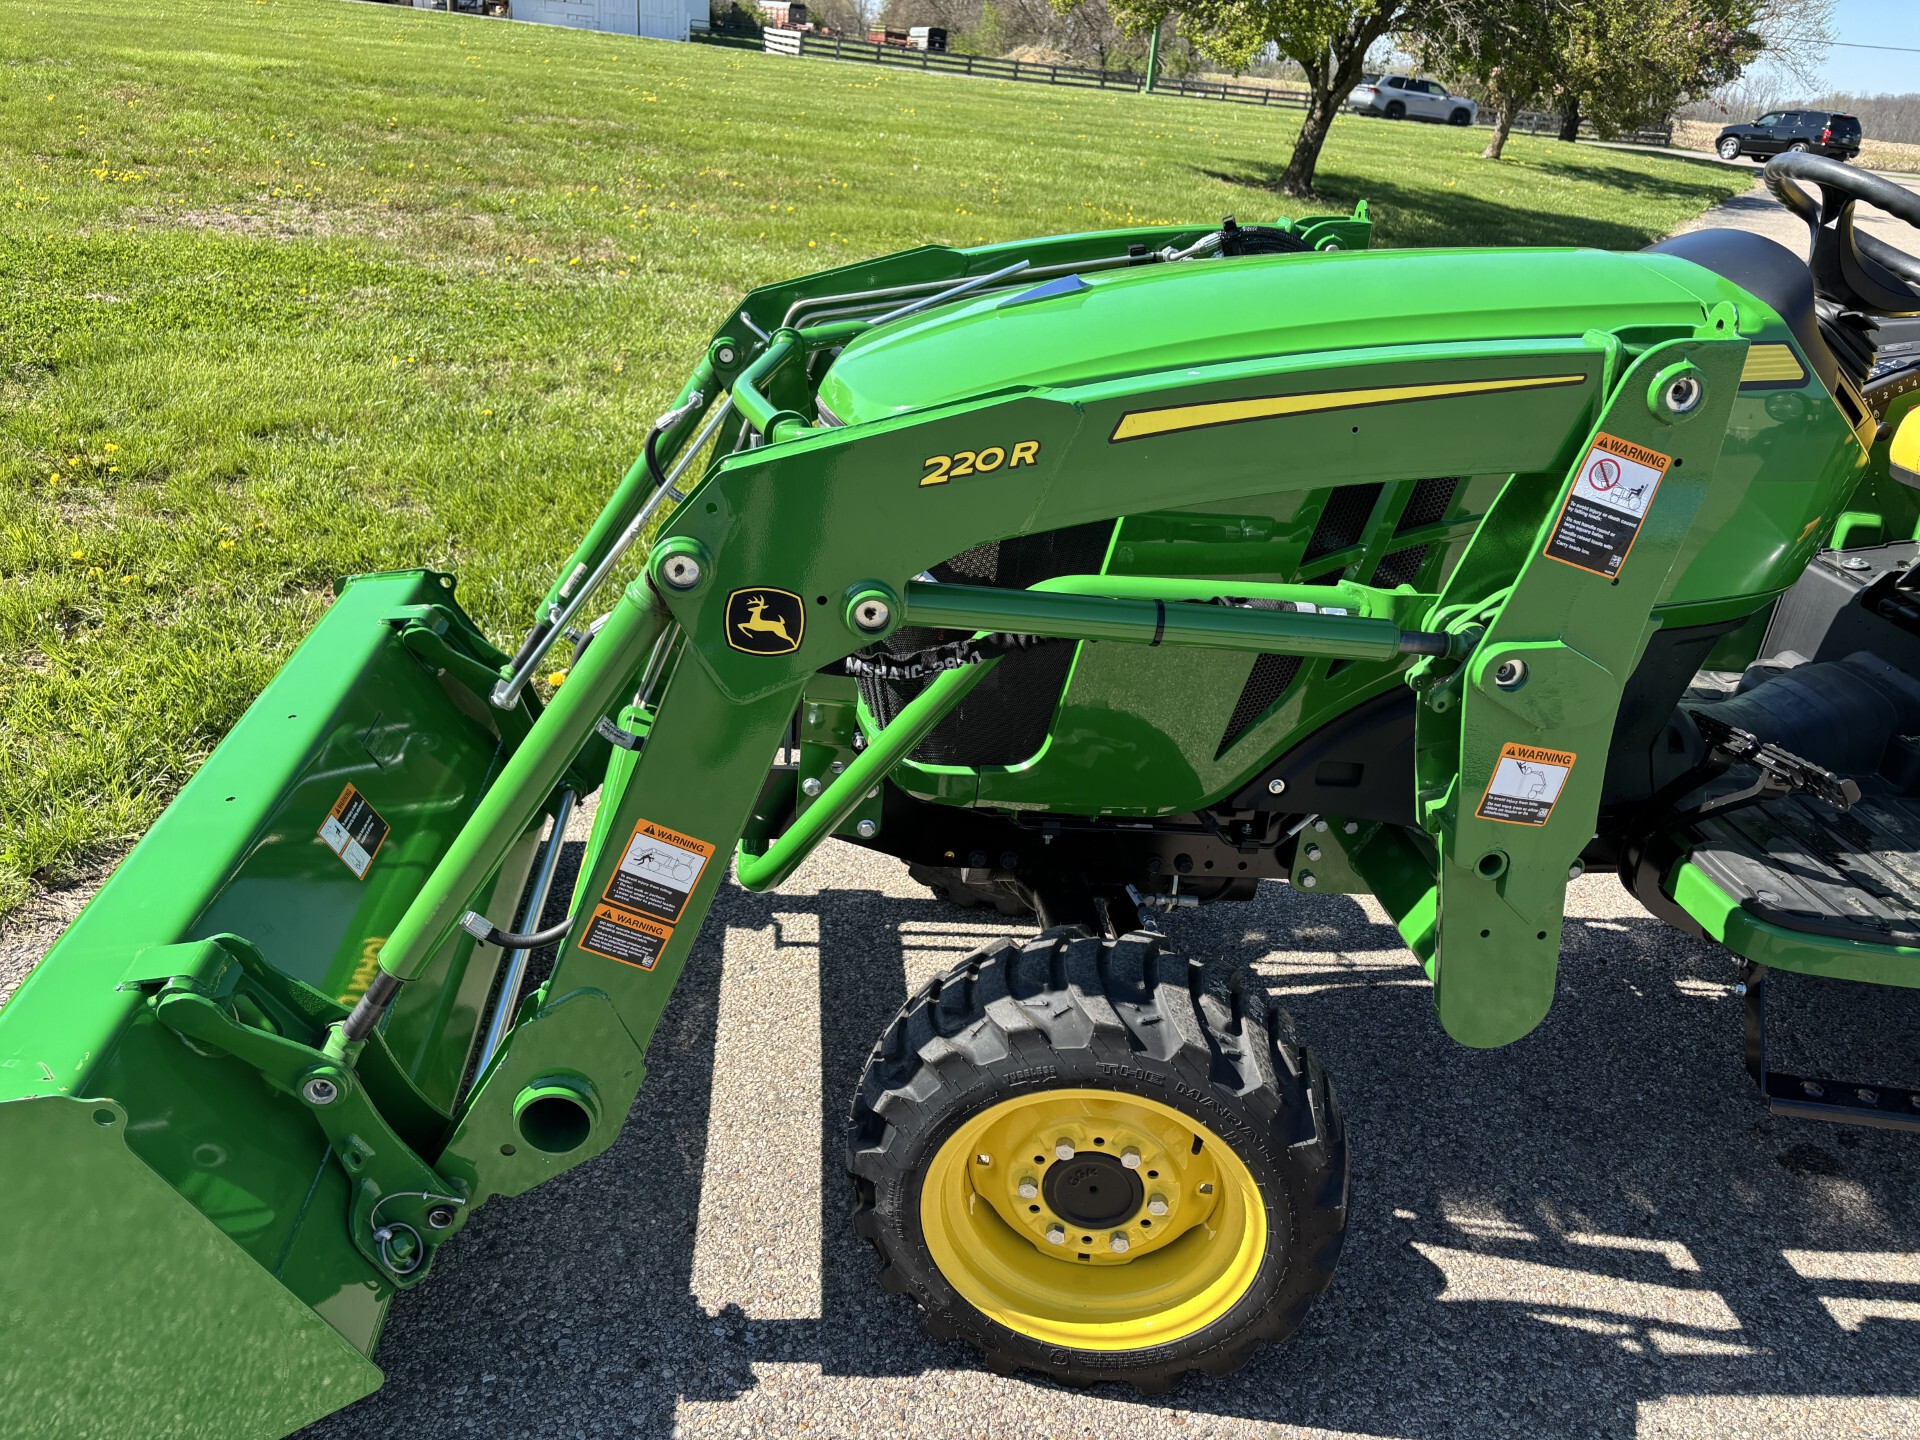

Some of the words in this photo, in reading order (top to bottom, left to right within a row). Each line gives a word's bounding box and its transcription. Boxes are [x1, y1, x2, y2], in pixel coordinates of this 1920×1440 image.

[1609, 439, 1668, 469] WARNING
[1518, 747, 1572, 765] WARNING
[657, 829, 705, 853] WARNING
[617, 914, 664, 936] WARNING
[1095, 1061, 1167, 1086] THE
